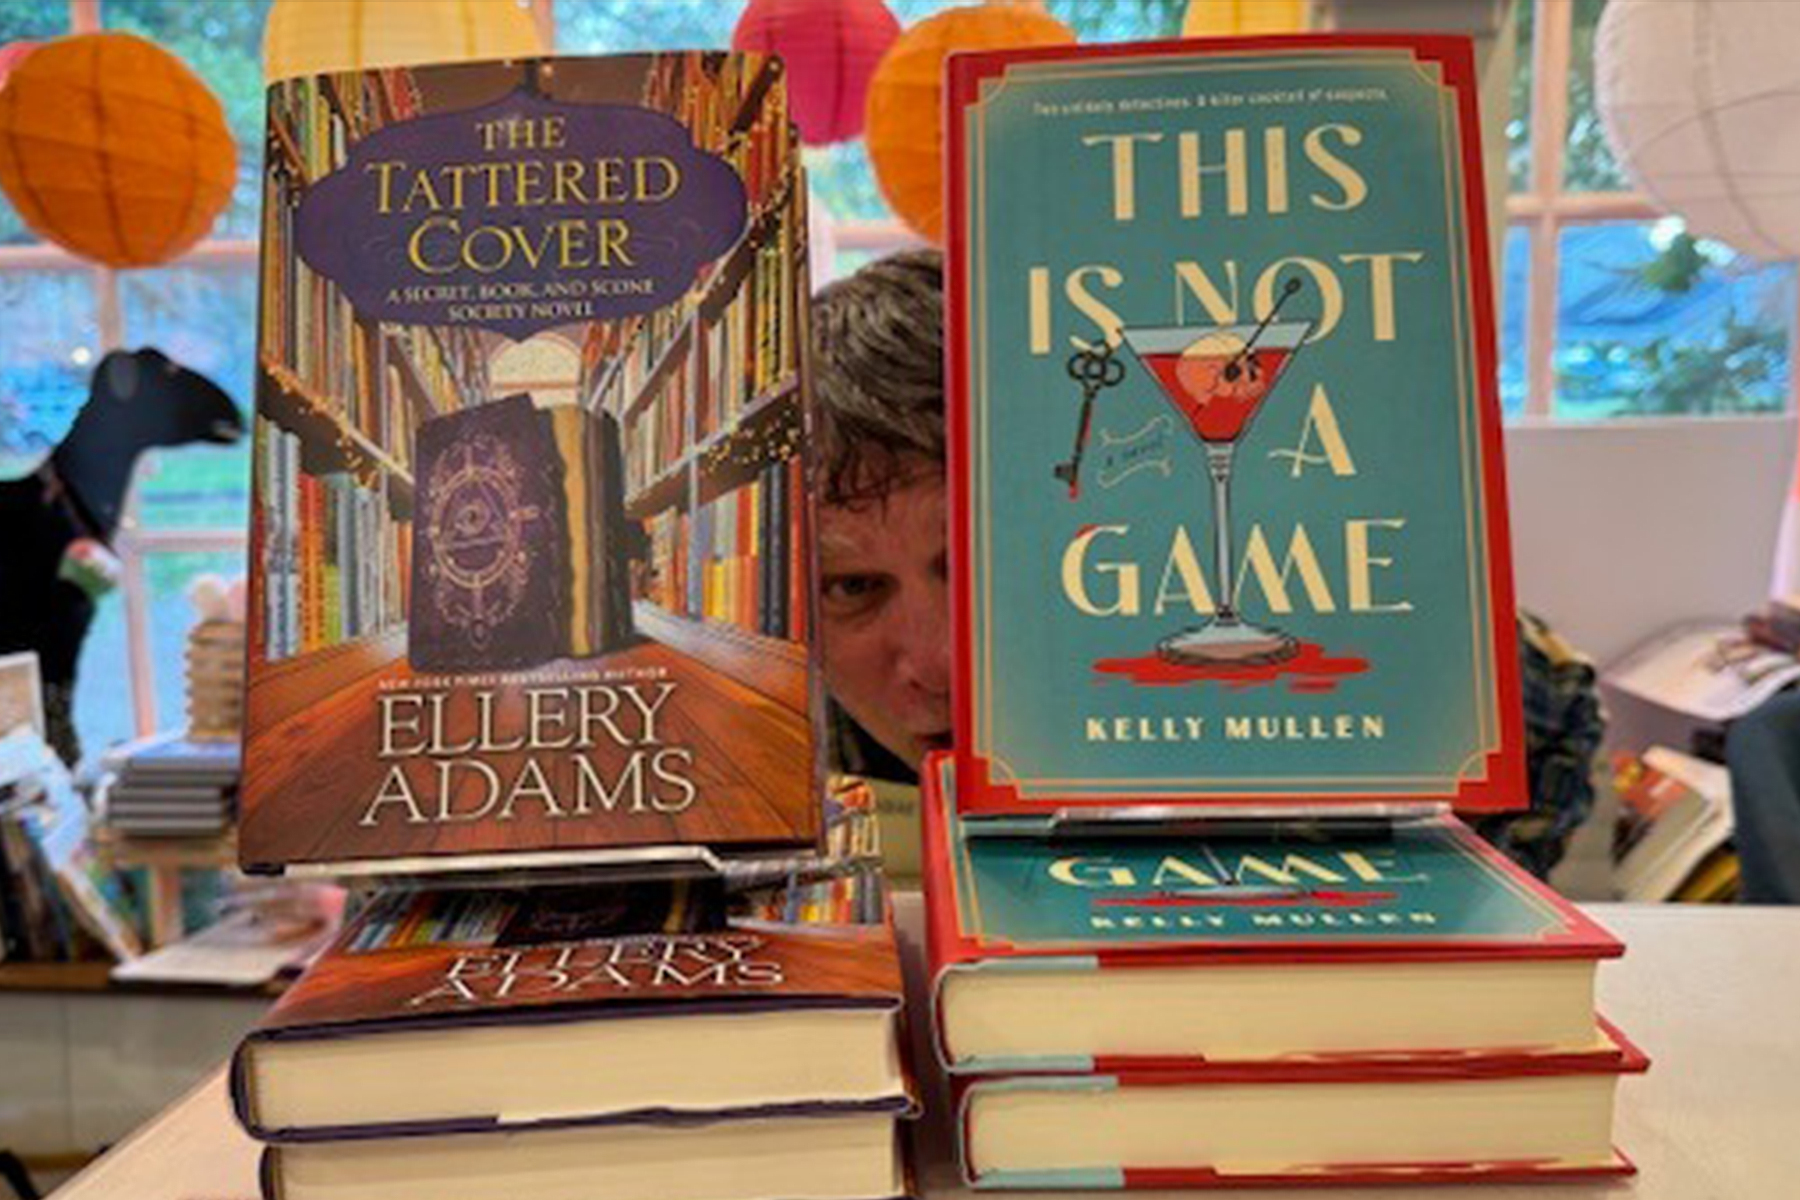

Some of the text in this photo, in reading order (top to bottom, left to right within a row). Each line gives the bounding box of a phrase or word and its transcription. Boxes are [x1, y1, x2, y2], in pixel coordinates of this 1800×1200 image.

[474, 116, 568, 152] THE
[364, 156, 681, 214] TATTERED
[1082, 122, 1368, 220] THIS
[409, 214, 638, 275] COVER
[388, 286, 402, 305] A
[542, 279, 588, 299] AND
[591, 277, 655, 298] SCONE
[447, 300, 595, 322] SOCIETY NOVEL
[1029, 251, 1424, 354] IS NOT
[1268, 383, 1356, 478] A
[1061, 518, 1414, 616] GAME
[377, 682, 677, 758] ELLERY
[1085, 714, 1385, 742] KELLY MULLEN
[358, 748, 697, 827] ADAMS
[1048, 850, 1430, 887] GAME
[410, 961, 784, 1005] ADAMS
